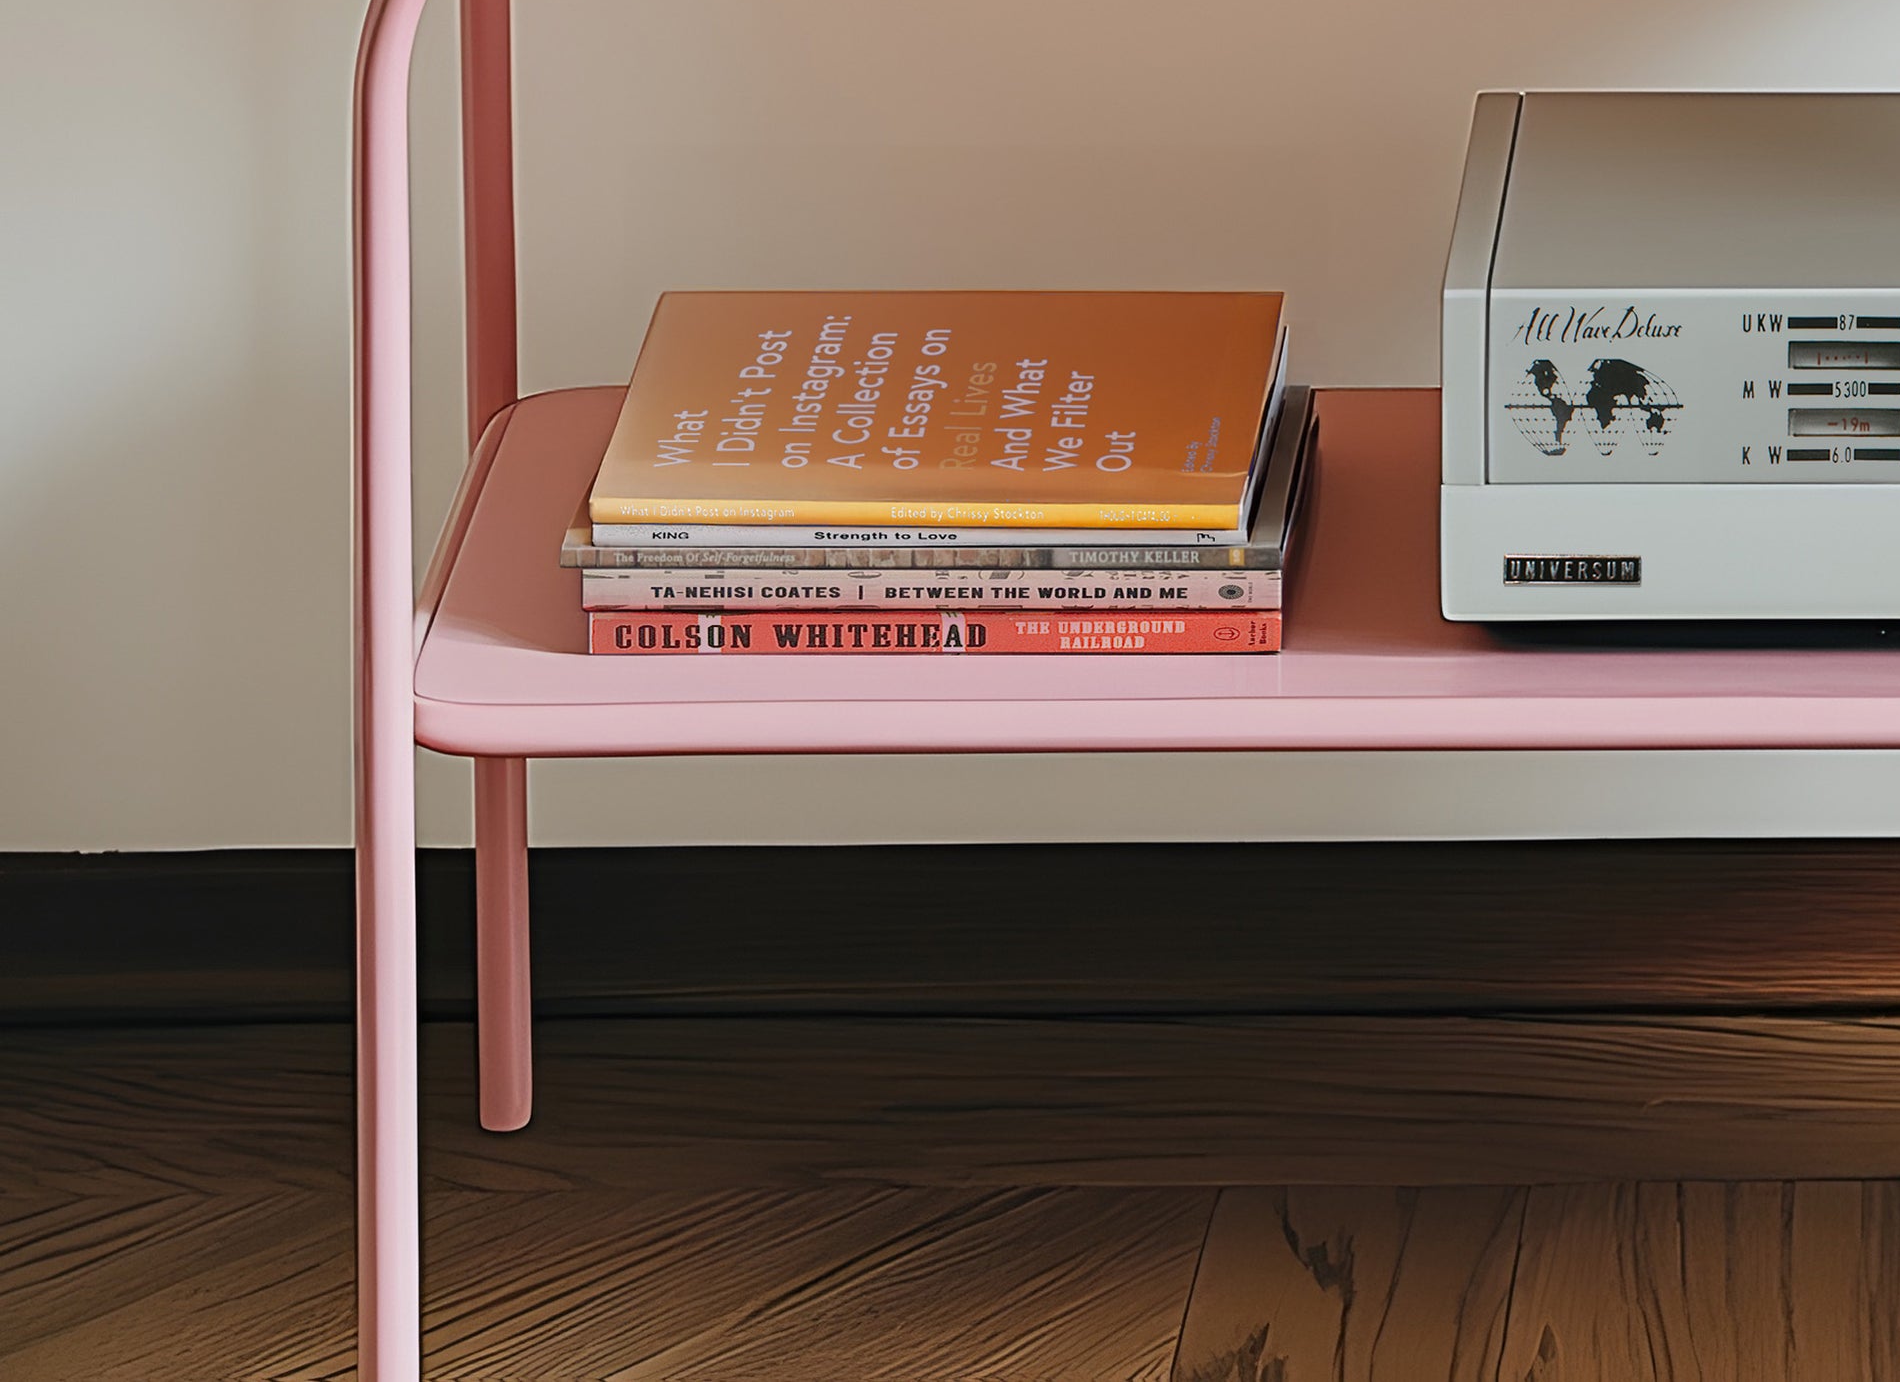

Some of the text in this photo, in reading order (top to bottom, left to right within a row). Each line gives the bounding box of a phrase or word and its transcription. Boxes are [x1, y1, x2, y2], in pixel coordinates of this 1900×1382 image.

[1510, 307, 1559, 345] All
[1612, 306, 1683, 339] Deluxe
[1743, 314, 1782, 333] UKW
[1839, 314, 1855, 331] 87
[739, 329, 792, 378] Post
[778, 315, 852, 468] on Instagram:
[881, 328, 952, 470] of Essays on
[1835, 381, 1866, 398] 5300
[827, 332, 898, 469] A Collection
[716, 388, 772, 452] Didn't
[939, 361, 997, 470] Real Lives
[990, 358, 1048, 472] And What
[1042, 370, 1095, 472] We Filter
[653, 409, 708, 467] What
[1095, 430, 1136, 472] Out
[1832, 447, 1851, 464] 6.0
[620, 506, 648, 516] What
[660, 506, 692, 517] Didn't
[695, 506, 719, 517] Post
[723, 509, 736, 517] on
[739, 506, 795, 520] Instagram
[891, 507, 1044, 522] Edited by Chrissy Stockton
[652, 531, 689, 540] KING
[814, 531, 957, 541] Strength to Love
[614, 551, 795, 564] The Freedom Of Self-Forgetfulness
[1069, 551, 1200, 564] TIMOTHY KELLER
[1510, 560, 1635, 580] UNIVERSUM
[651, 586, 841, 598] TA-NEHISI COATES
[885, 587, 1188, 599] BETWEEN THE WORLD AND ME
[615, 623, 986, 649] COLSON WHITEHEAD
[1015, 620, 1186, 635] THE UNDERGROUND
[1060, 636, 1145, 649] RAILROAD
